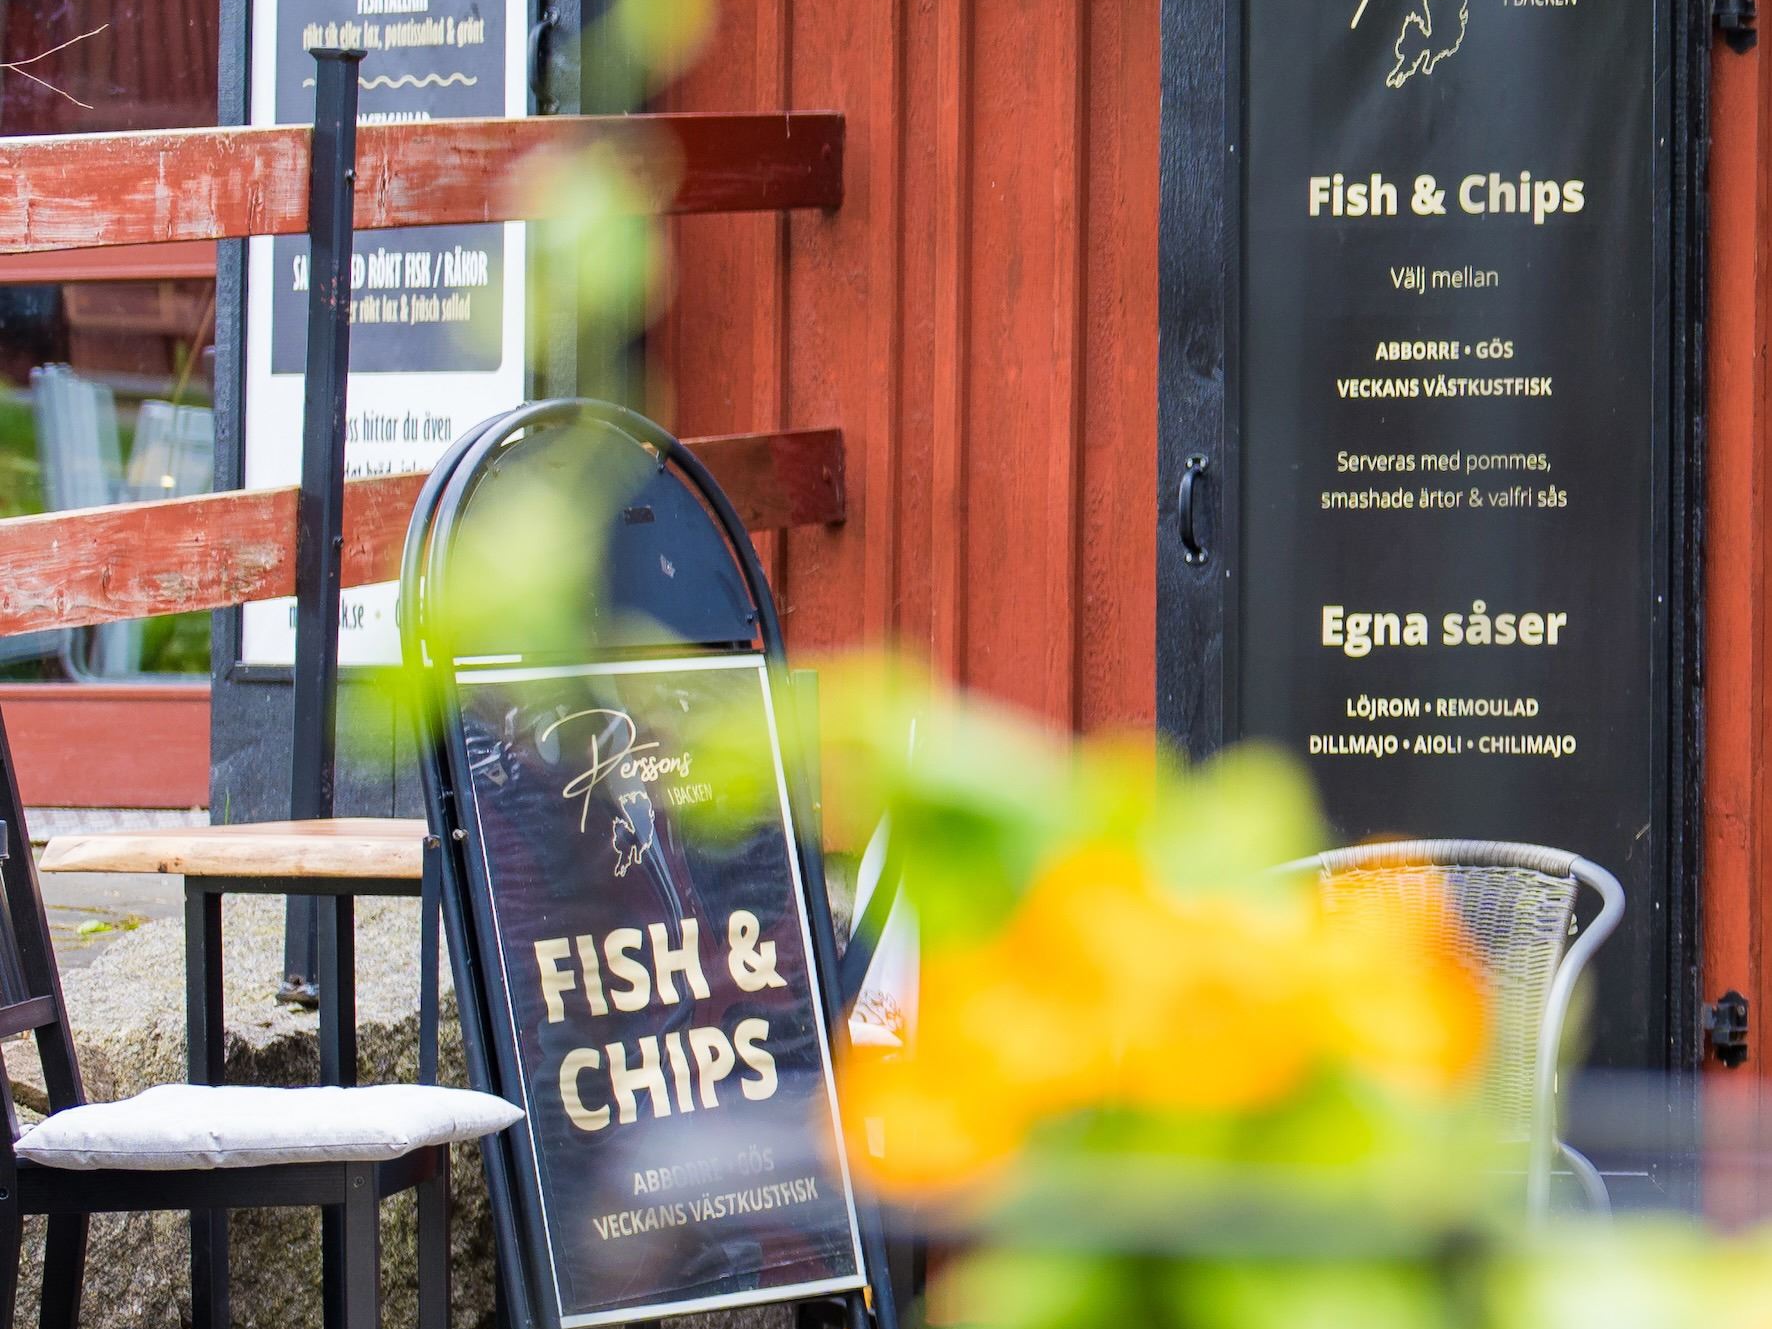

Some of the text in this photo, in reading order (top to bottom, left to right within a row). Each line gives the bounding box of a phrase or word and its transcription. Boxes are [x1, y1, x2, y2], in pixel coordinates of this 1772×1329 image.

[446, 15, 456, 45] &
[1308, 169, 1586, 226] Fish & Chips
[368, 247, 403, 289] RÖKT
[404, 251, 432, 288] FISK
[444, 245, 489, 288] RÄKOR
[1389, 264, 1500, 296] Välj mellan
[359, 294, 381, 324] rökt
[382, 294, 400, 323] lax
[400, 293, 410, 322] &
[1374, 336, 1515, 362] ABBORRE GÖS
[1336, 373, 1554, 399] VECKANS VÄSTKUSTFISK
[362, 410, 399, 442] hittar
[402, 410, 419, 442] du
[422, 411, 452, 442] även
[1336, 449, 1417, 474] Serveras
[1420, 448, 1462, 473] med
[1320, 485, 1416, 511] smashade
[1418, 486, 1465, 510] ärtor
[1467, 486, 1485, 509] &
[1536, 483, 1569, 509] sås
[1321, 598, 1569, 658] Egna såser
[1345, 693, 1540, 722] LÖJROM REMOULAD
[1308, 733, 1578, 759] DILLMAJO AIOLI CHILIMAJO
[540, 707, 694, 834] Perssons
[675, 782, 713, 803] BACKEN
[532, 908, 789, 1025] FISH &
[558, 1017, 779, 1133] CHIPS
[593, 1176, 819, 1241] VECKANS VÄSTKUSTFISK
